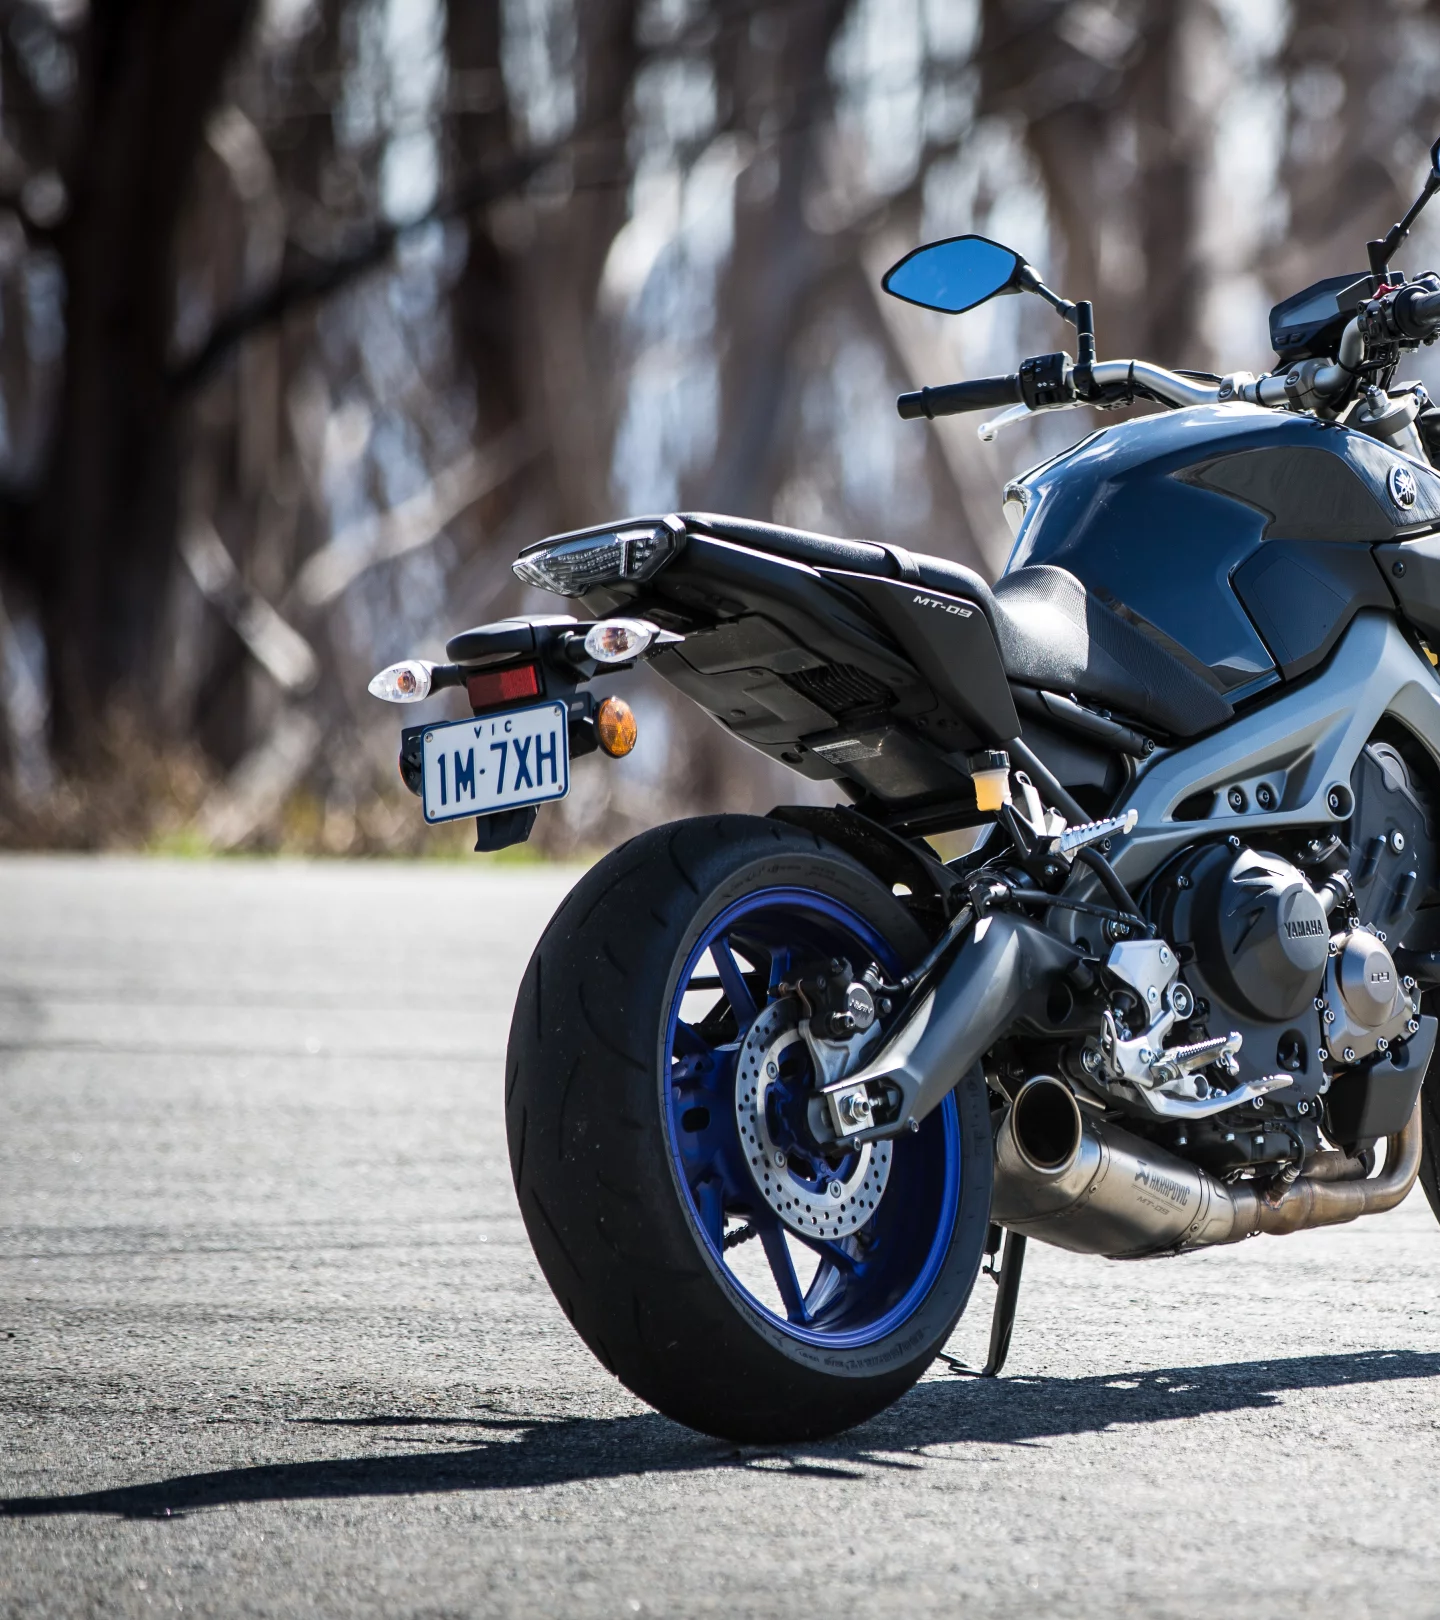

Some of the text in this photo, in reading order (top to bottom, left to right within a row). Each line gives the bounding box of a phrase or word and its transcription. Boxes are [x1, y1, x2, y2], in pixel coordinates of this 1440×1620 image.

[912, 595, 973, 618] MT-09
[474, 720, 512, 739] VIC
[1284, 919, 1324, 939] YAMAHA
[1136, 1196, 1170, 1215] MT-09
